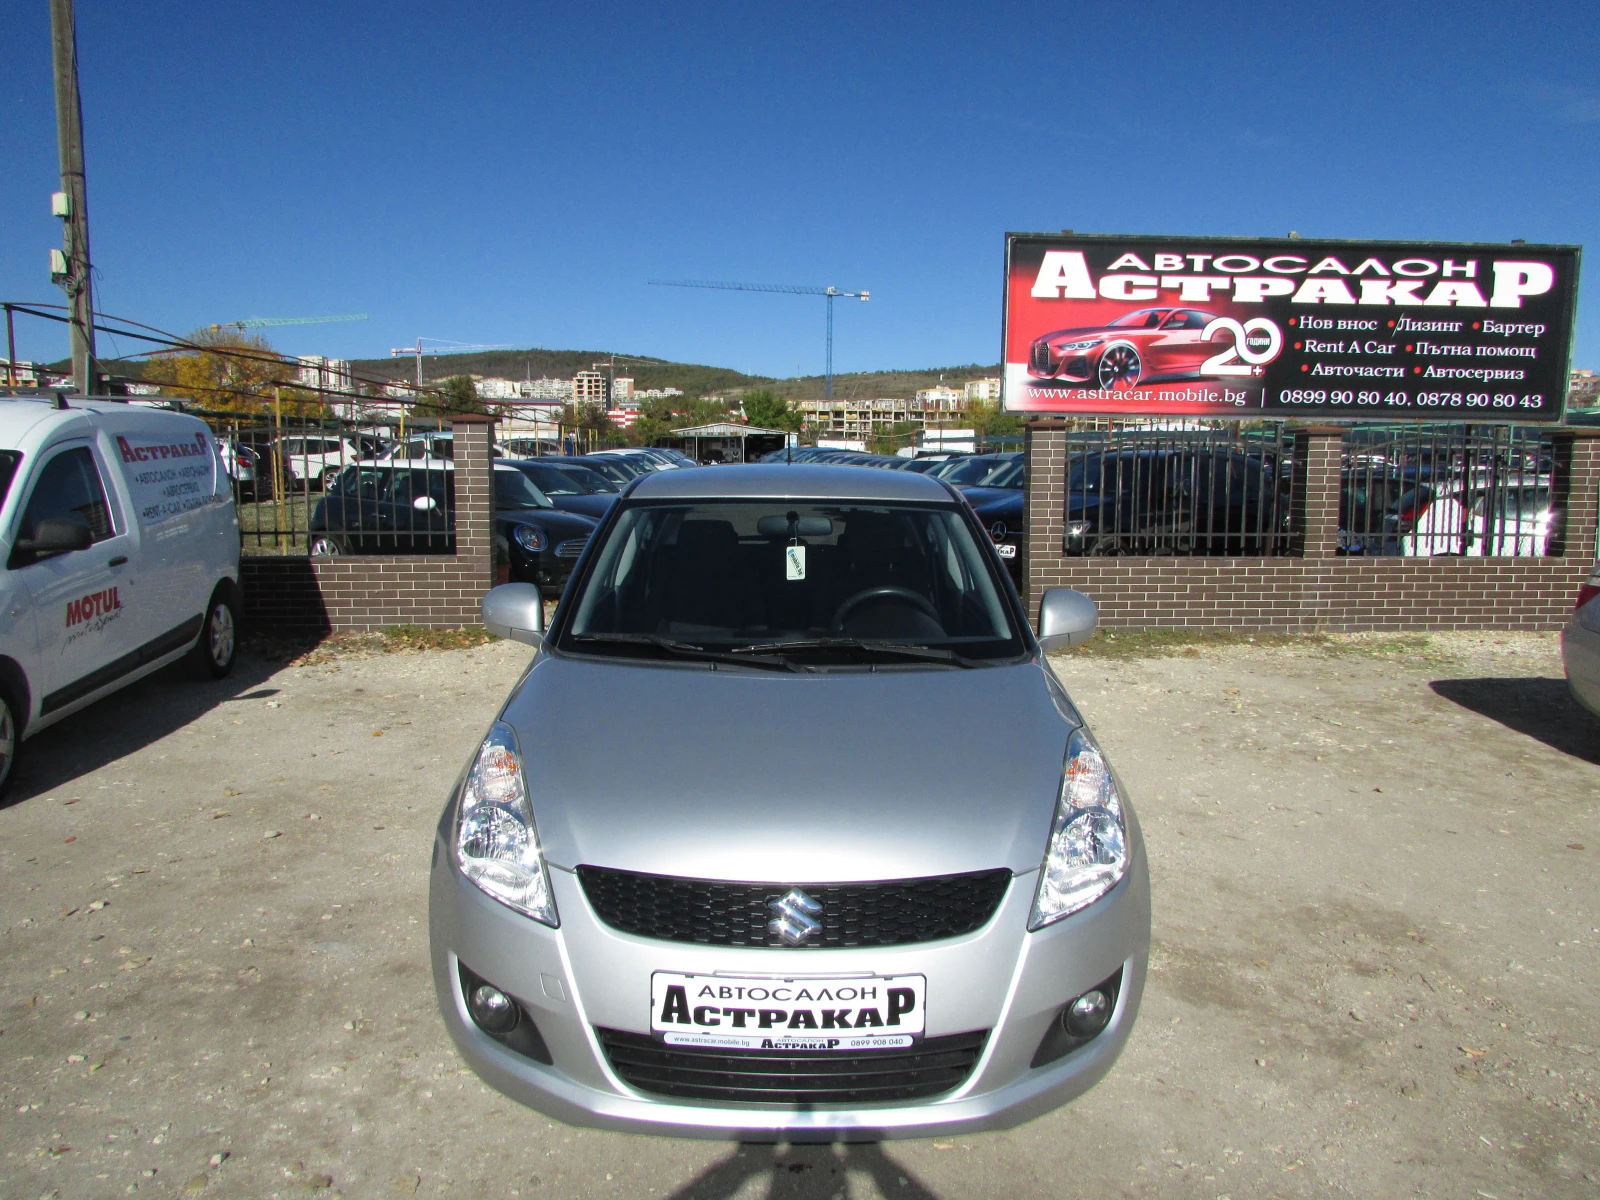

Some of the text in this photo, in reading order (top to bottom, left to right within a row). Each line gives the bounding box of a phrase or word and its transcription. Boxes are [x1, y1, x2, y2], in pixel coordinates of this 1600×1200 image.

[1106, 253, 1477, 278] АВТОСАЛОН
[1031, 251, 1555, 308] АСТРАКАР
[1299, 316, 1378, 331] Нов внос
[1397, 318, 1463, 332] Лизинг
[1482, 320, 1545, 337] Бартер
[1304, 340, 1345, 354] Rent
[1364, 341, 1396, 355] Car
[1415, 342, 1536, 359] Пътна помощ
[1310, 363, 1405, 378] Авточасти
[1423, 365, 1524, 382] Автосервиз
[1028, 385, 1246, 405] www.astracar.mobile.bg
[1280, 389, 1327, 404] 0899
[1330, 390, 1353, 405] 90
[1356, 391, 1380, 405] 80
[1416, 392, 1462, 406] 0878
[1465, 393, 1489, 407] 90
[1493, 394, 1515, 407] 80
[1519, 395, 1542, 408] 43
[66, 586, 121, 628] MOTUL
[697, 985, 877, 1001] АВТОСАЛОН
[661, 985, 916, 1029] АСТРАКАР
[673, 1036, 750, 1047] www.astracar.mobile.bg
[850, 1038, 903, 1047] 0899 908 040
